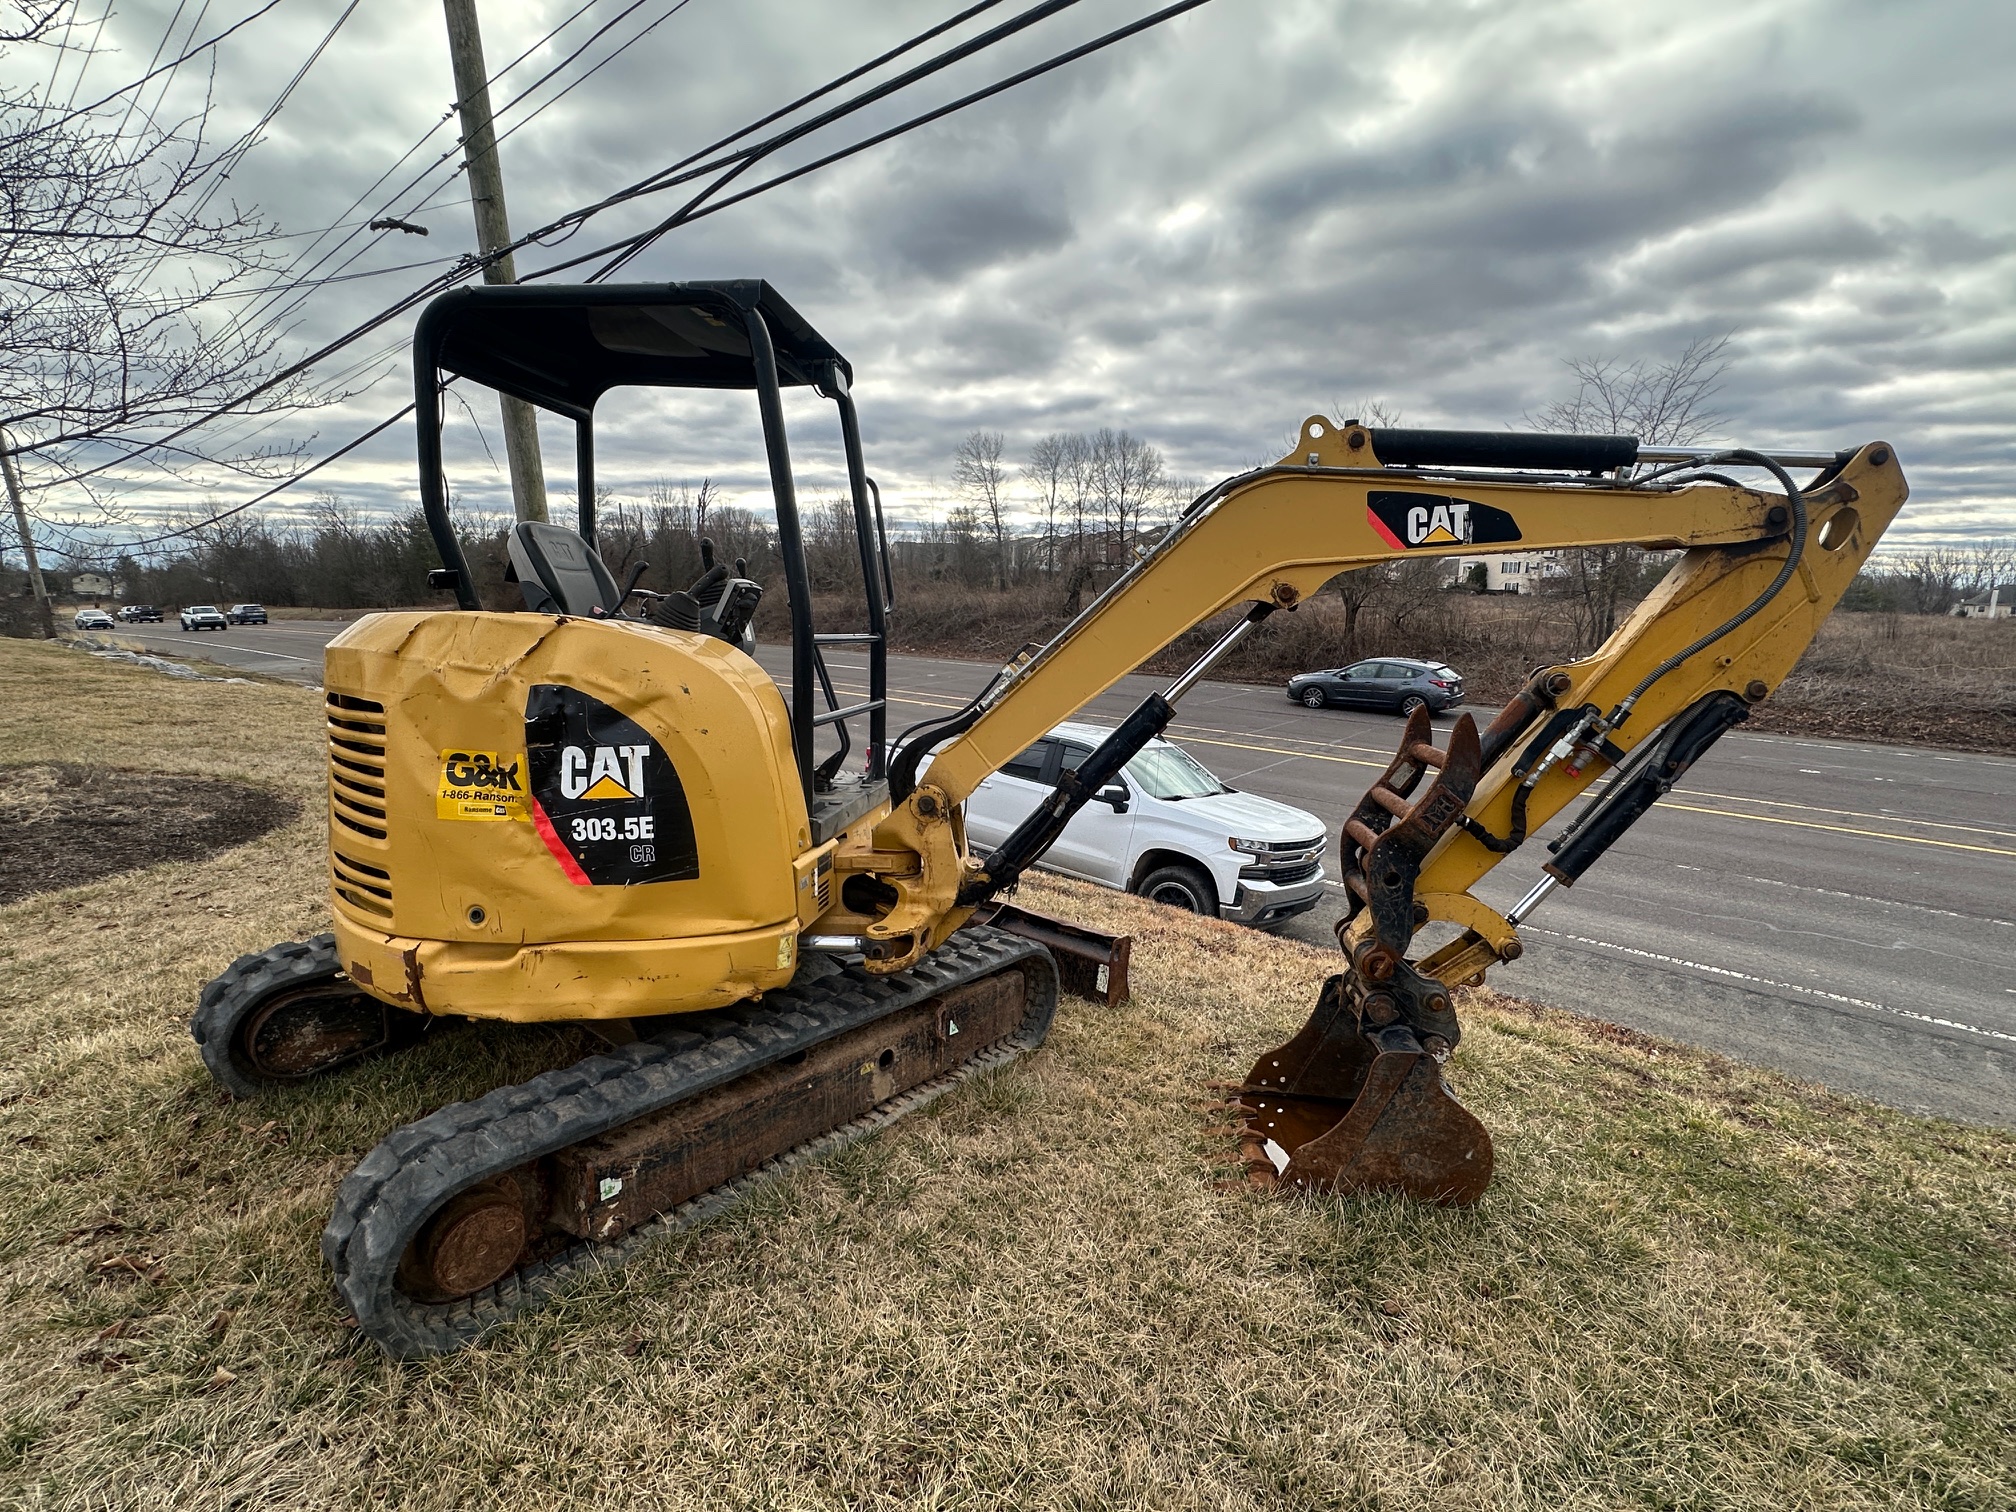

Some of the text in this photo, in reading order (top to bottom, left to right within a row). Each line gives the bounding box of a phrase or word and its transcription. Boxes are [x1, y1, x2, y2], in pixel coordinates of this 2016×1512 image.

[1407, 504, 1469, 544] CAT
[561, 745, 650, 799] CAT
[572, 816, 654, 841] 303.5E
[630, 844, 655, 862] CR
